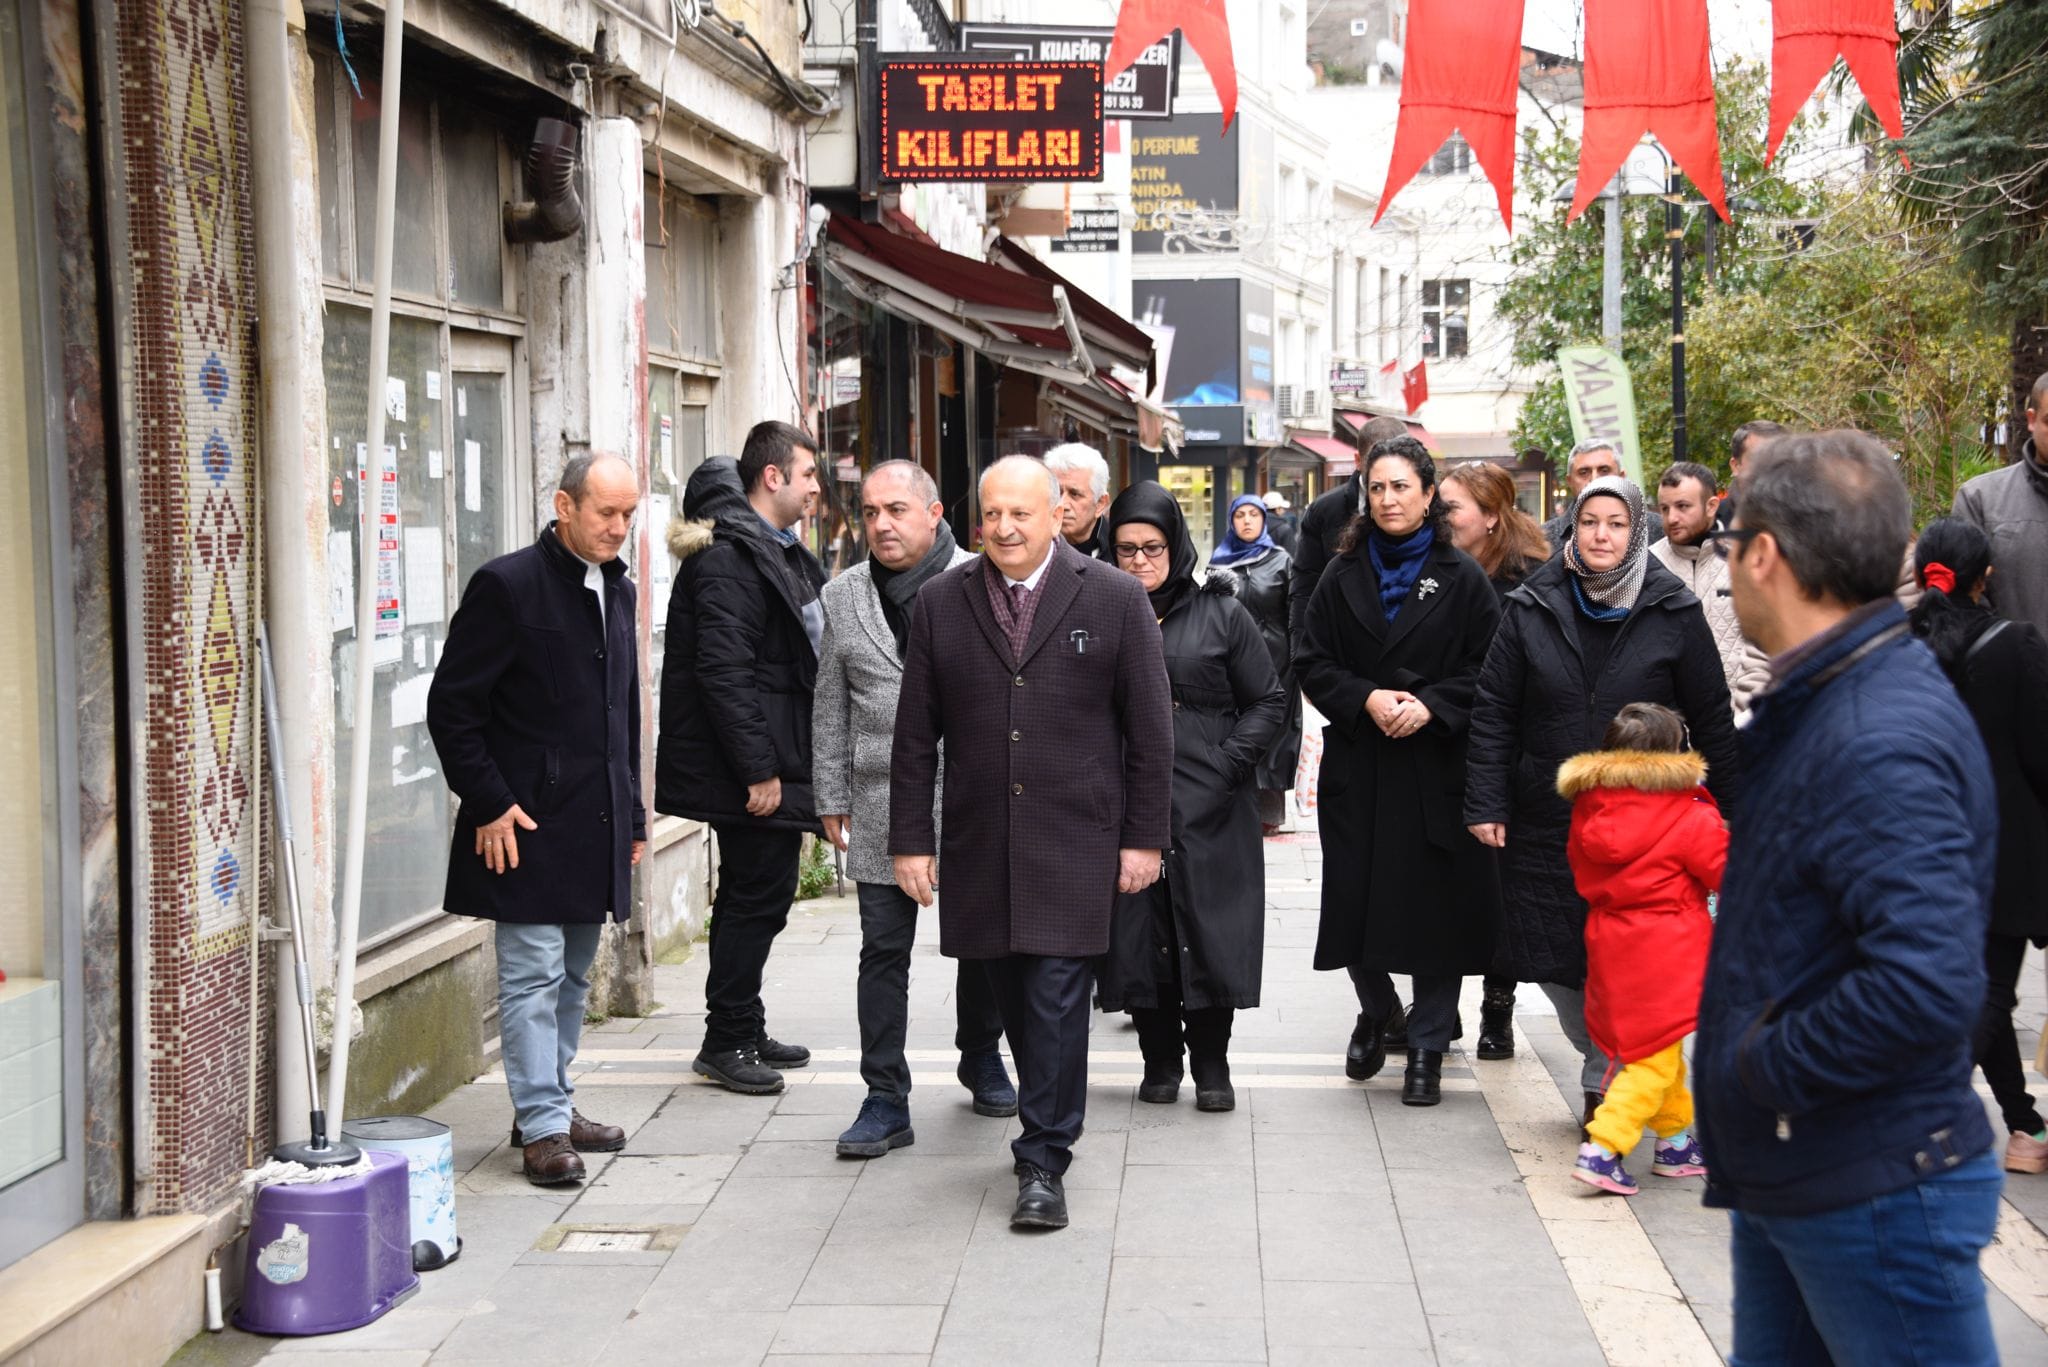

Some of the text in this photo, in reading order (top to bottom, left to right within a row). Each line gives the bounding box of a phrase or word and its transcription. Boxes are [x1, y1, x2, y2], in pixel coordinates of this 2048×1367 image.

[1040, 38, 1100, 61] KUAFÖR
[917, 75, 1062, 112] TABLET
[897, 130, 1080, 167] KILIFLARI
[1142, 136, 1200, 156] PERFUME
